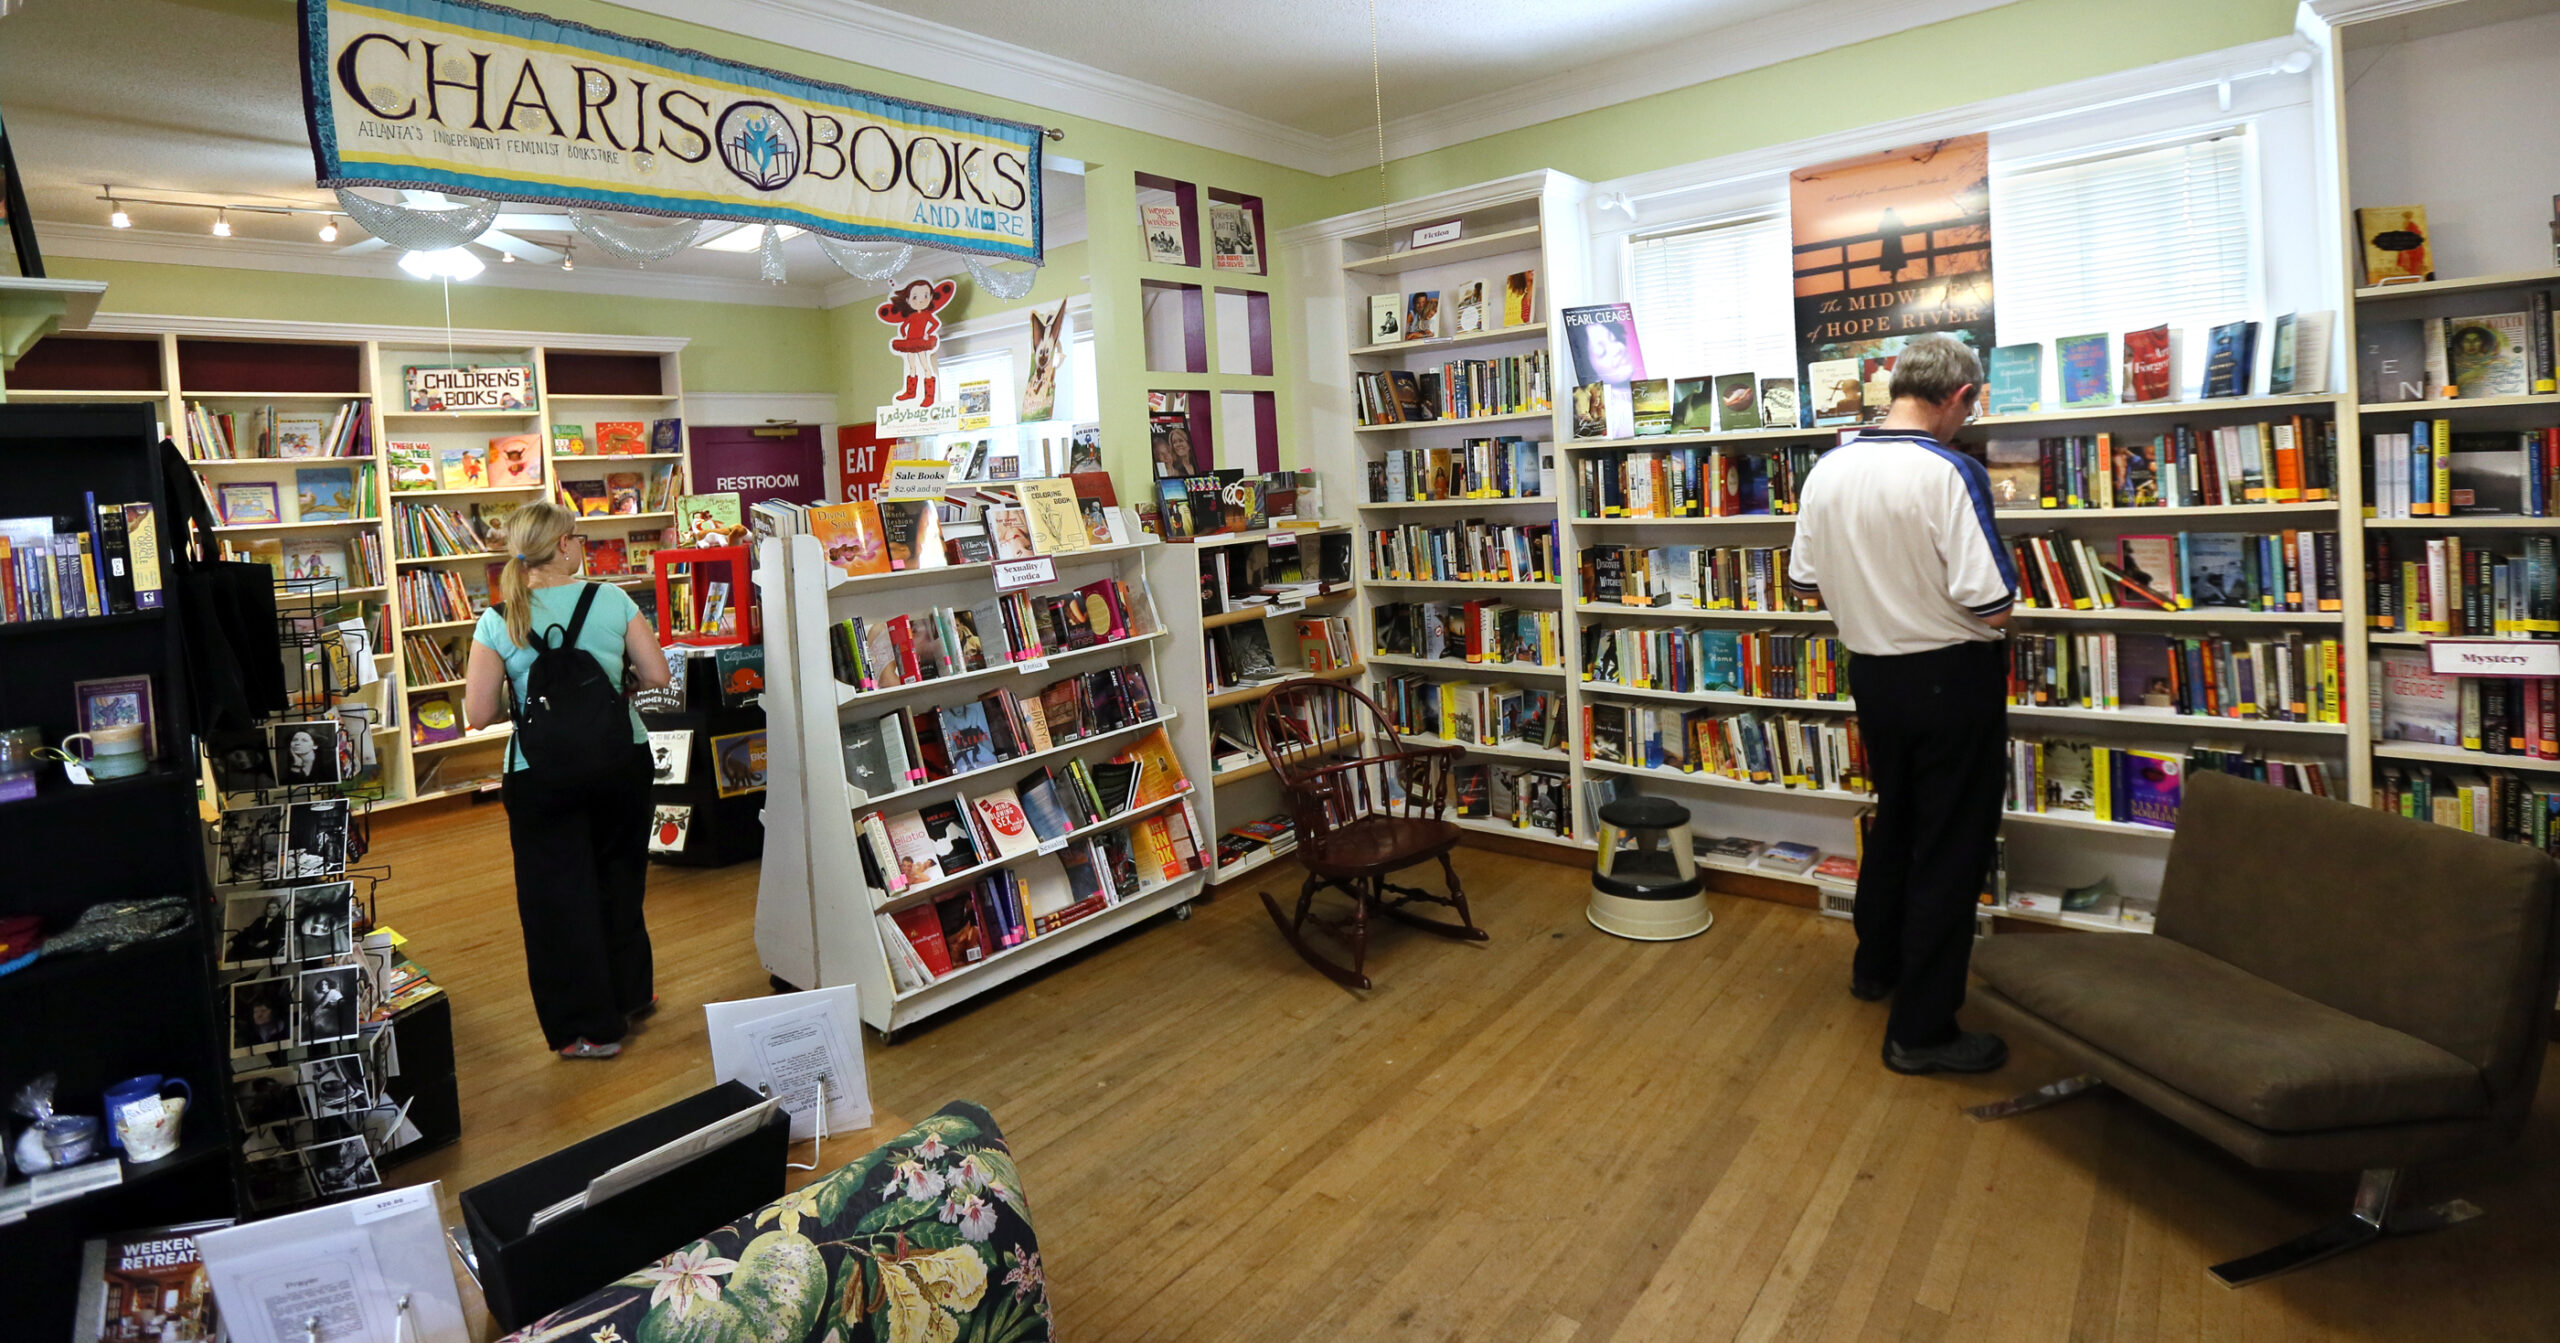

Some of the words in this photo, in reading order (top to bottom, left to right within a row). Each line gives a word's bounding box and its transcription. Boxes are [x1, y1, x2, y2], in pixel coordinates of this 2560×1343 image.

[336, 33, 711, 163] CHARIS
[803, 110, 1026, 211] BOOKS
[358, 121, 424, 141] ATLANTA'S
[433, 130, 502, 151] INDEPENDENT
[506, 140, 560, 157] FEMINIST
[912, 201, 962, 229] AND
[1147, 207, 1175, 215] WOMEN
[1215, 222, 1235, 231] UNITE
[1423, 229, 1450, 240] Fiction
[1819, 298, 1842, 314] The
[1848, 283, 1961, 312] MIDWIE
[1565, 312, 1595, 327] PEARL
[1596, 309, 1632, 324] CLEAGE
[1806, 323, 1823, 343] of
[1827, 315, 1891, 338] HOPE
[1902, 305, 1980, 330] RIVER
[424, 369, 520, 389] CHILDREN'S
[445, 390, 498, 406] BOOKS
[879, 406, 928, 426] Ladybug
[392, 442, 413, 451] THERE
[415, 442, 431, 451] WAS
[846, 446, 876, 474] EAT
[716, 474, 800, 491] RESTROOM
[895, 471, 916, 480] Sale
[917, 471, 945, 480] Books
[894, 484, 916, 494] $2.98
[917, 484, 931, 493] and
[932, 486, 942, 496] up
[1031, 490, 1062, 499] COLORING
[817, 511, 848, 522] DIVINE
[885, 511, 906, 519] Whole
[886, 518, 914, 526] Lesbian
[1003, 562, 1039, 575] Sexuality
[1596, 558, 1620, 570] DISCOVER
[1012, 573, 1041, 583] Erotica
[2380, 596, 2392, 615] POCKET
[2461, 652, 2529, 665] Mystery
[1023, 661, 1044, 672] Erotica
[2386, 661, 2455, 682] ELIZAB
[1109, 669, 1119, 687] ZANE
[662, 687, 670, 696] IS
[671, 689, 679, 697] IT
[2393, 679, 2445, 699] GEORGE
[634, 697, 663, 708] SUMMER
[663, 697, 681, 707] YET?
[1031, 709, 1048, 738] DIRTY
[990, 808, 1014, 820] BLOWING
[997, 816, 1012, 828] SEX
[894, 830, 926, 846] ellatio
[1038, 838, 1067, 853] Sexuality
[123, 1236, 196, 1258] WEEKEN
[121, 1249, 202, 1272] RETREAT
